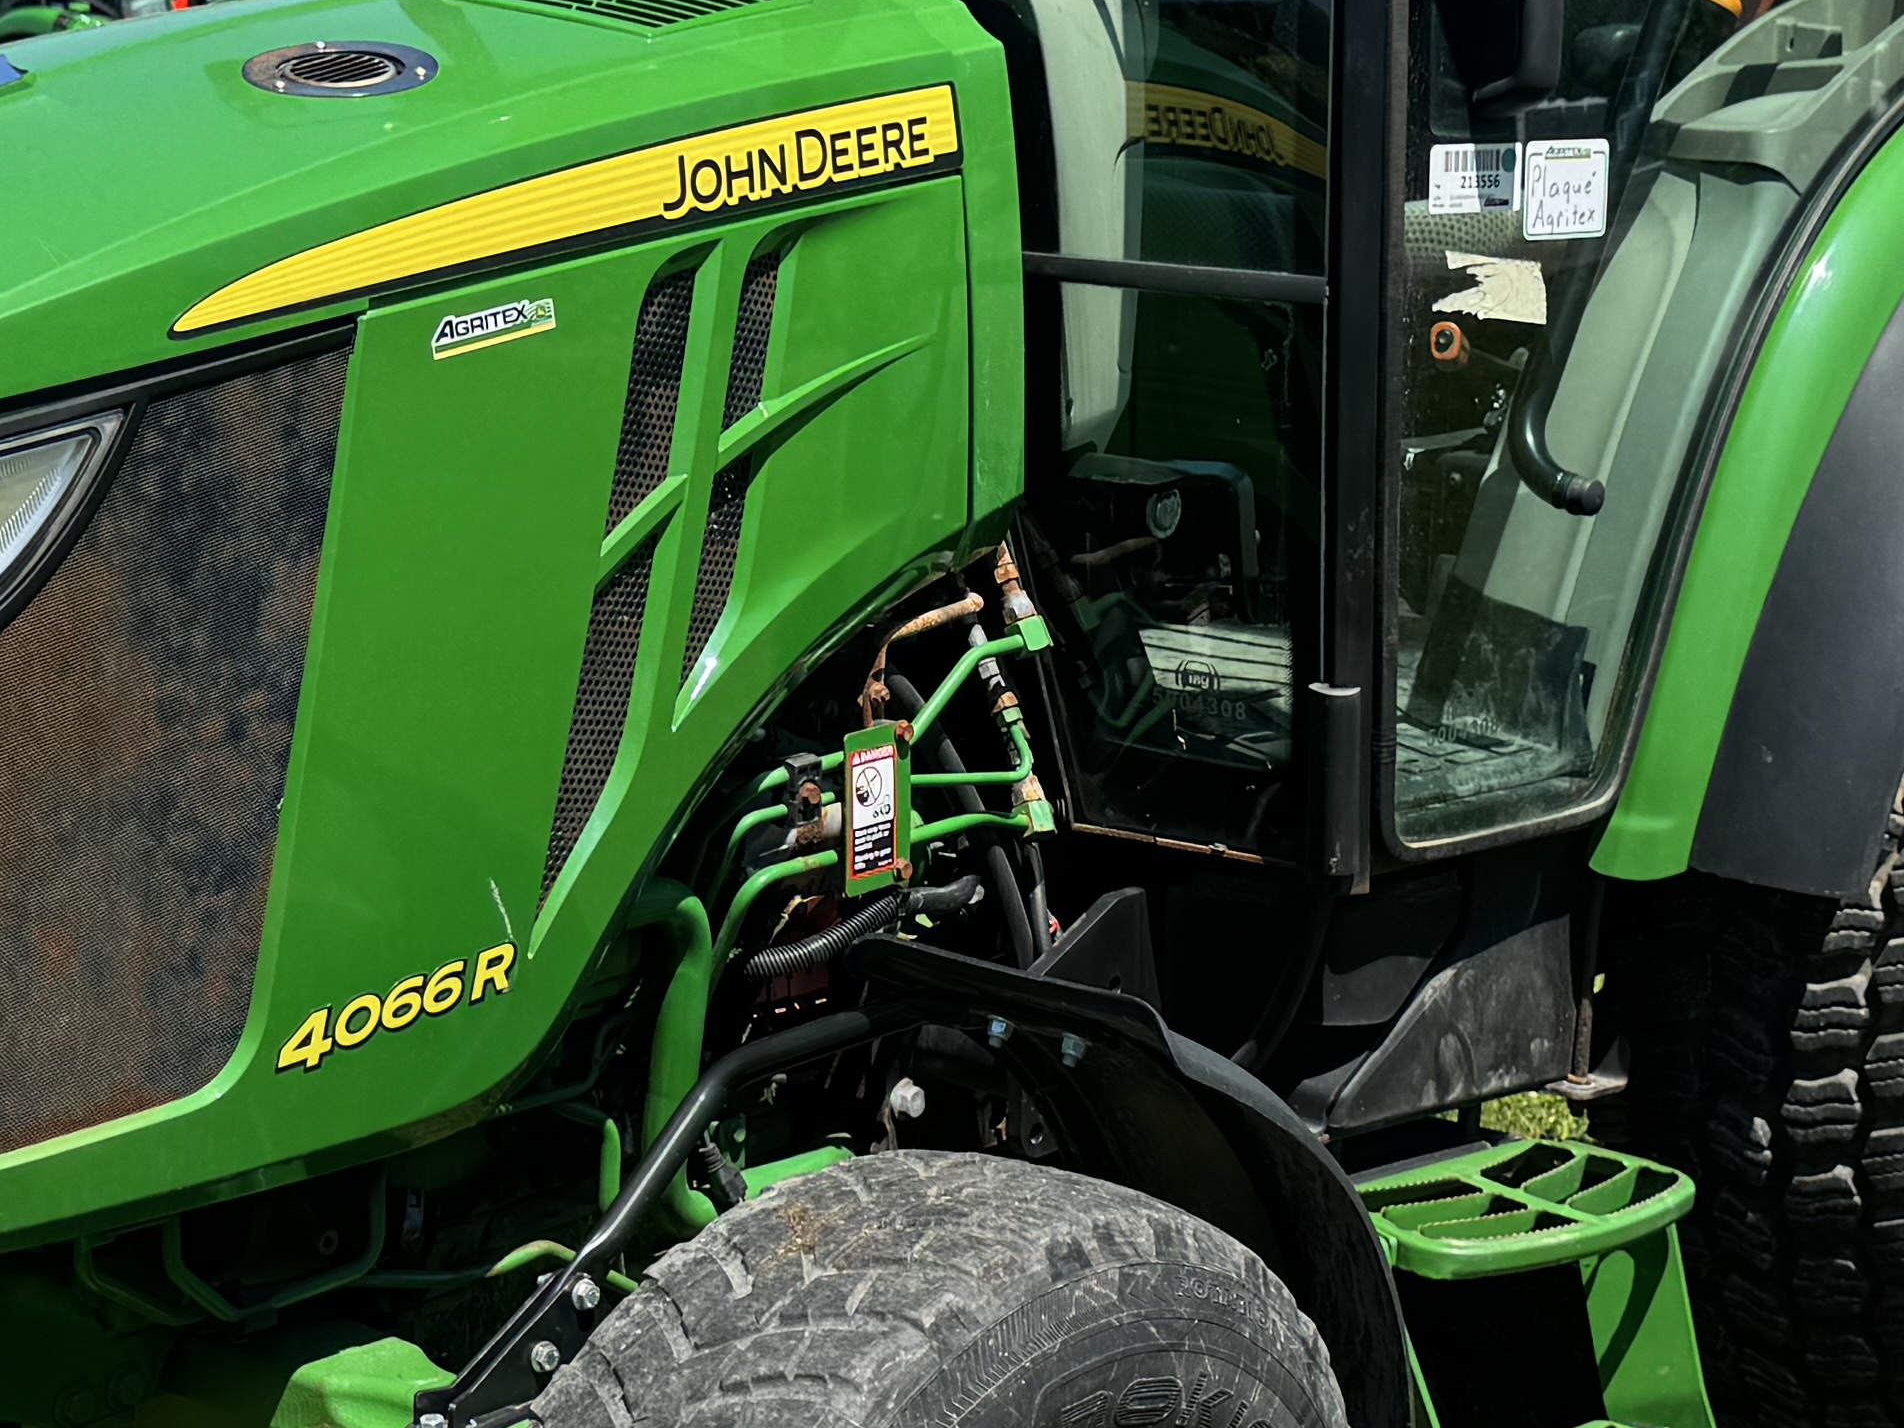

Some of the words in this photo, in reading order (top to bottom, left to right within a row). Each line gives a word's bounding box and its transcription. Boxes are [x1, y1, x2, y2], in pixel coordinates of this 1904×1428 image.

[662, 144, 788, 212] JOHN
[795, 116, 930, 181] DEERE
[1460, 174, 1501, 189] 213556
[435, 304, 528, 344] AGRITEX
[274, 956, 467, 1074] 4066
[468, 940, 517, 1006] R
